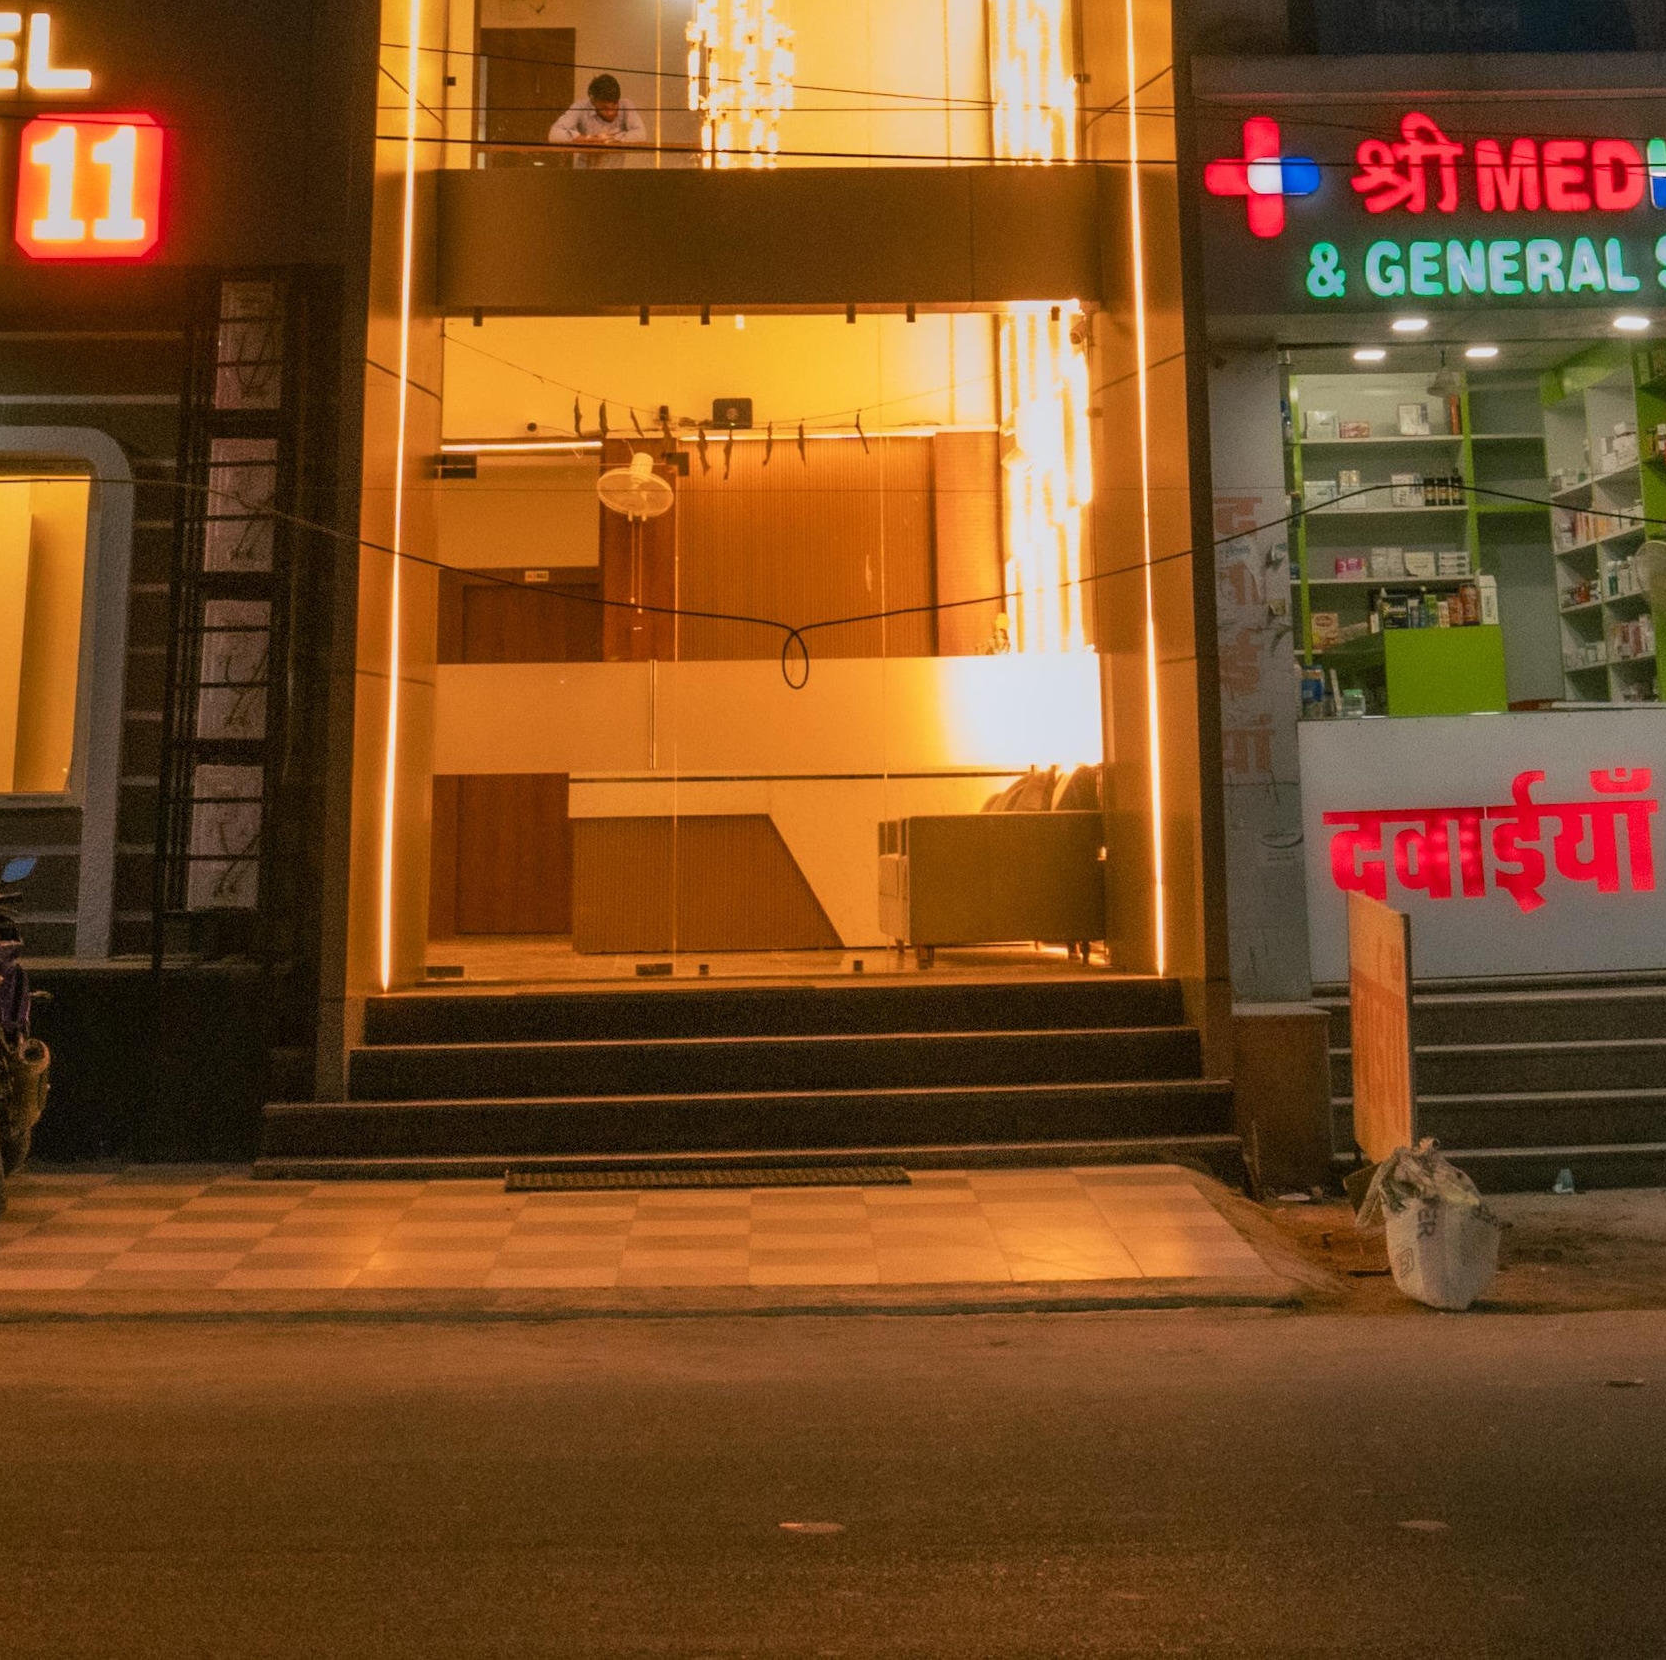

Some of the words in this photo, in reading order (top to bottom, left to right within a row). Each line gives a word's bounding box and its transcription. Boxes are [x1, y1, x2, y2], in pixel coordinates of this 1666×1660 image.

[30, 126, 146, 242] 11
[1350, 111, 1463, 214] श्री
[1305, 242, 1346, 299] &
[1364, 237, 1641, 297] GENERAL
[1322, 767, 1658, 914] दवाईयाँ
